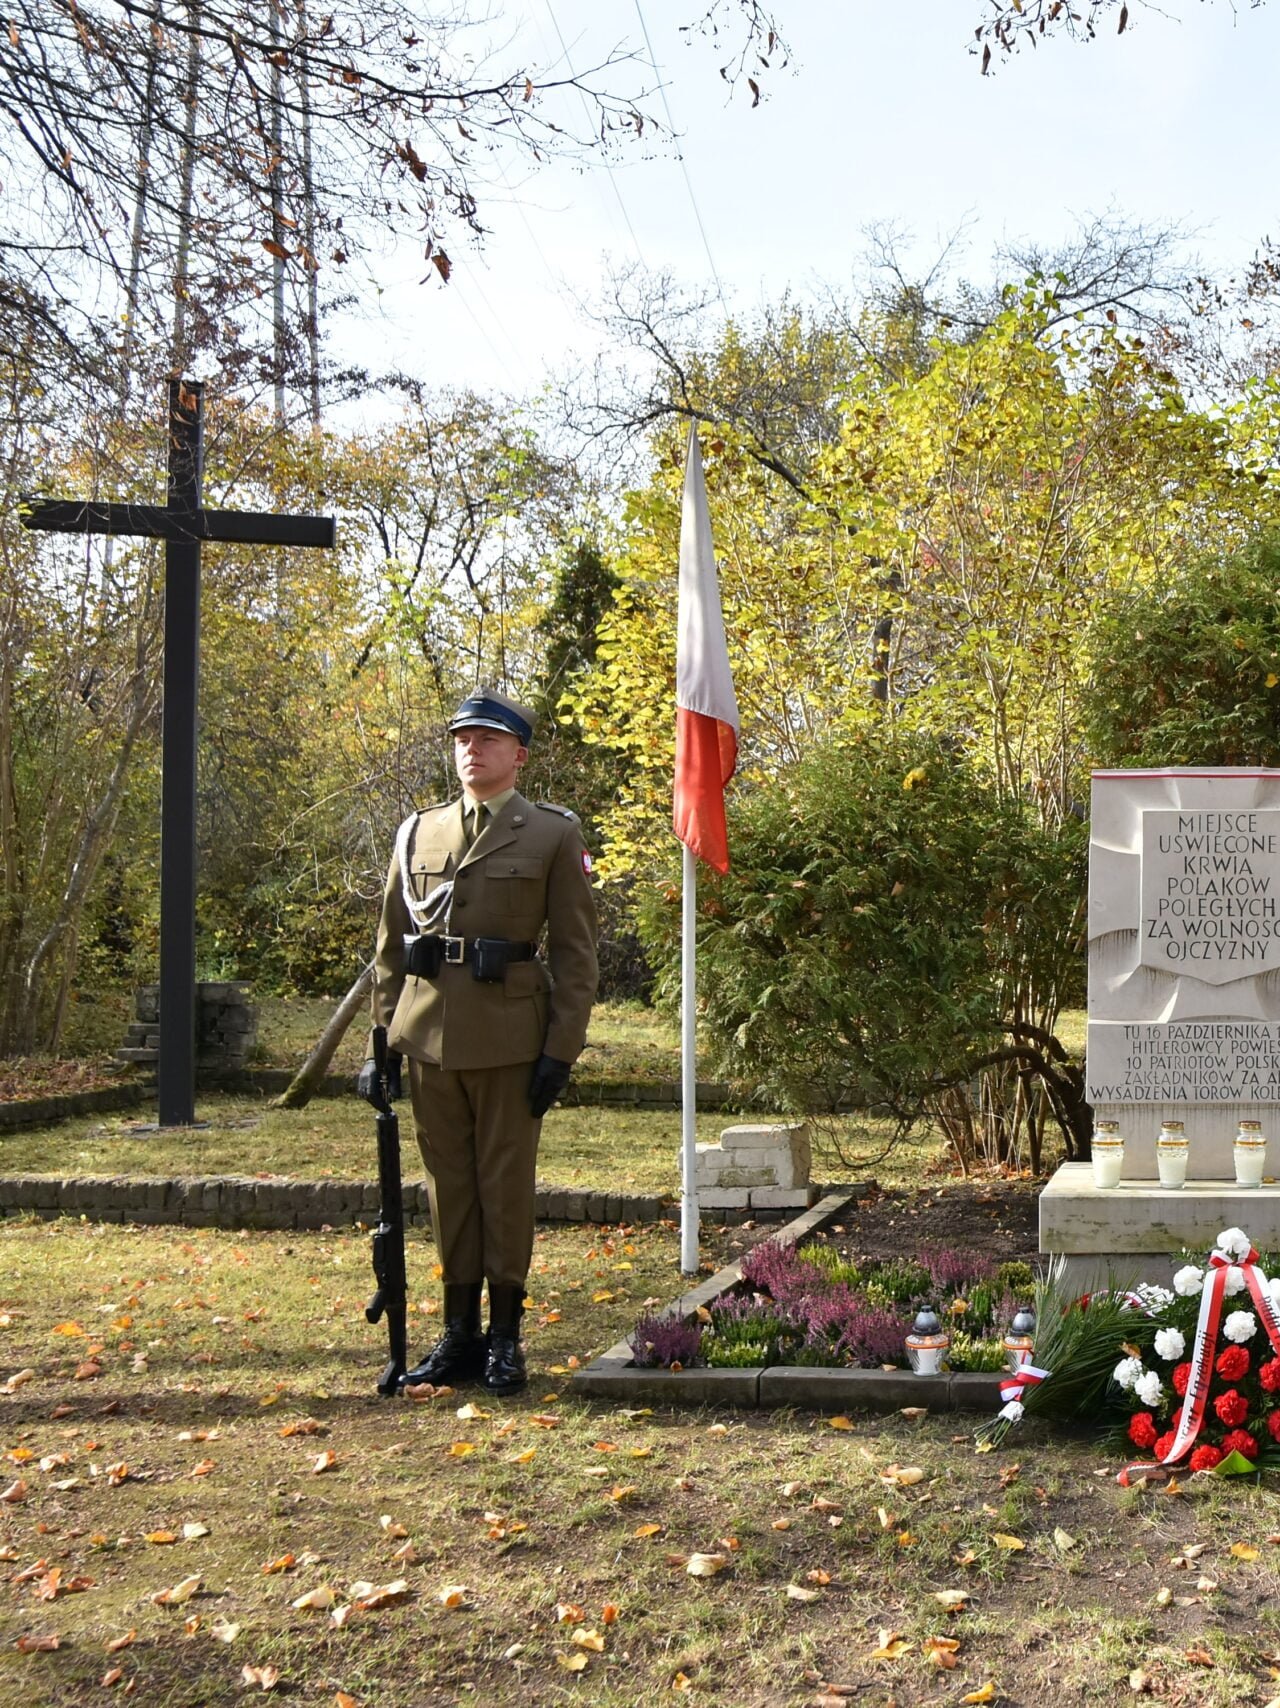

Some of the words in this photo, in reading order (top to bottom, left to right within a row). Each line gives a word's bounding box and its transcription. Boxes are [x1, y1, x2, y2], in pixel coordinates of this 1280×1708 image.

[1178, 814, 1258, 834] MIEJSCE
[1158, 897, 1276, 918] POLEGŁYCH
[1147, 919, 1174, 939] ZA
[1166, 940, 1270, 961] OJCZYZNY
[1123, 1025, 1141, 1040] TU
[1146, 1026, 1161, 1040] 16
[1131, 1040, 1225, 1055] HITLEROWCY
[1126, 1056, 1142, 1070] 10
[1149, 1054, 1229, 1070] PATRIOTÓW
[1241, 1070, 1260, 1085] ZA
[1089, 1085, 1188, 1101] WYSADZENIA
[1258, 1295, 1280, 1331] Rada
